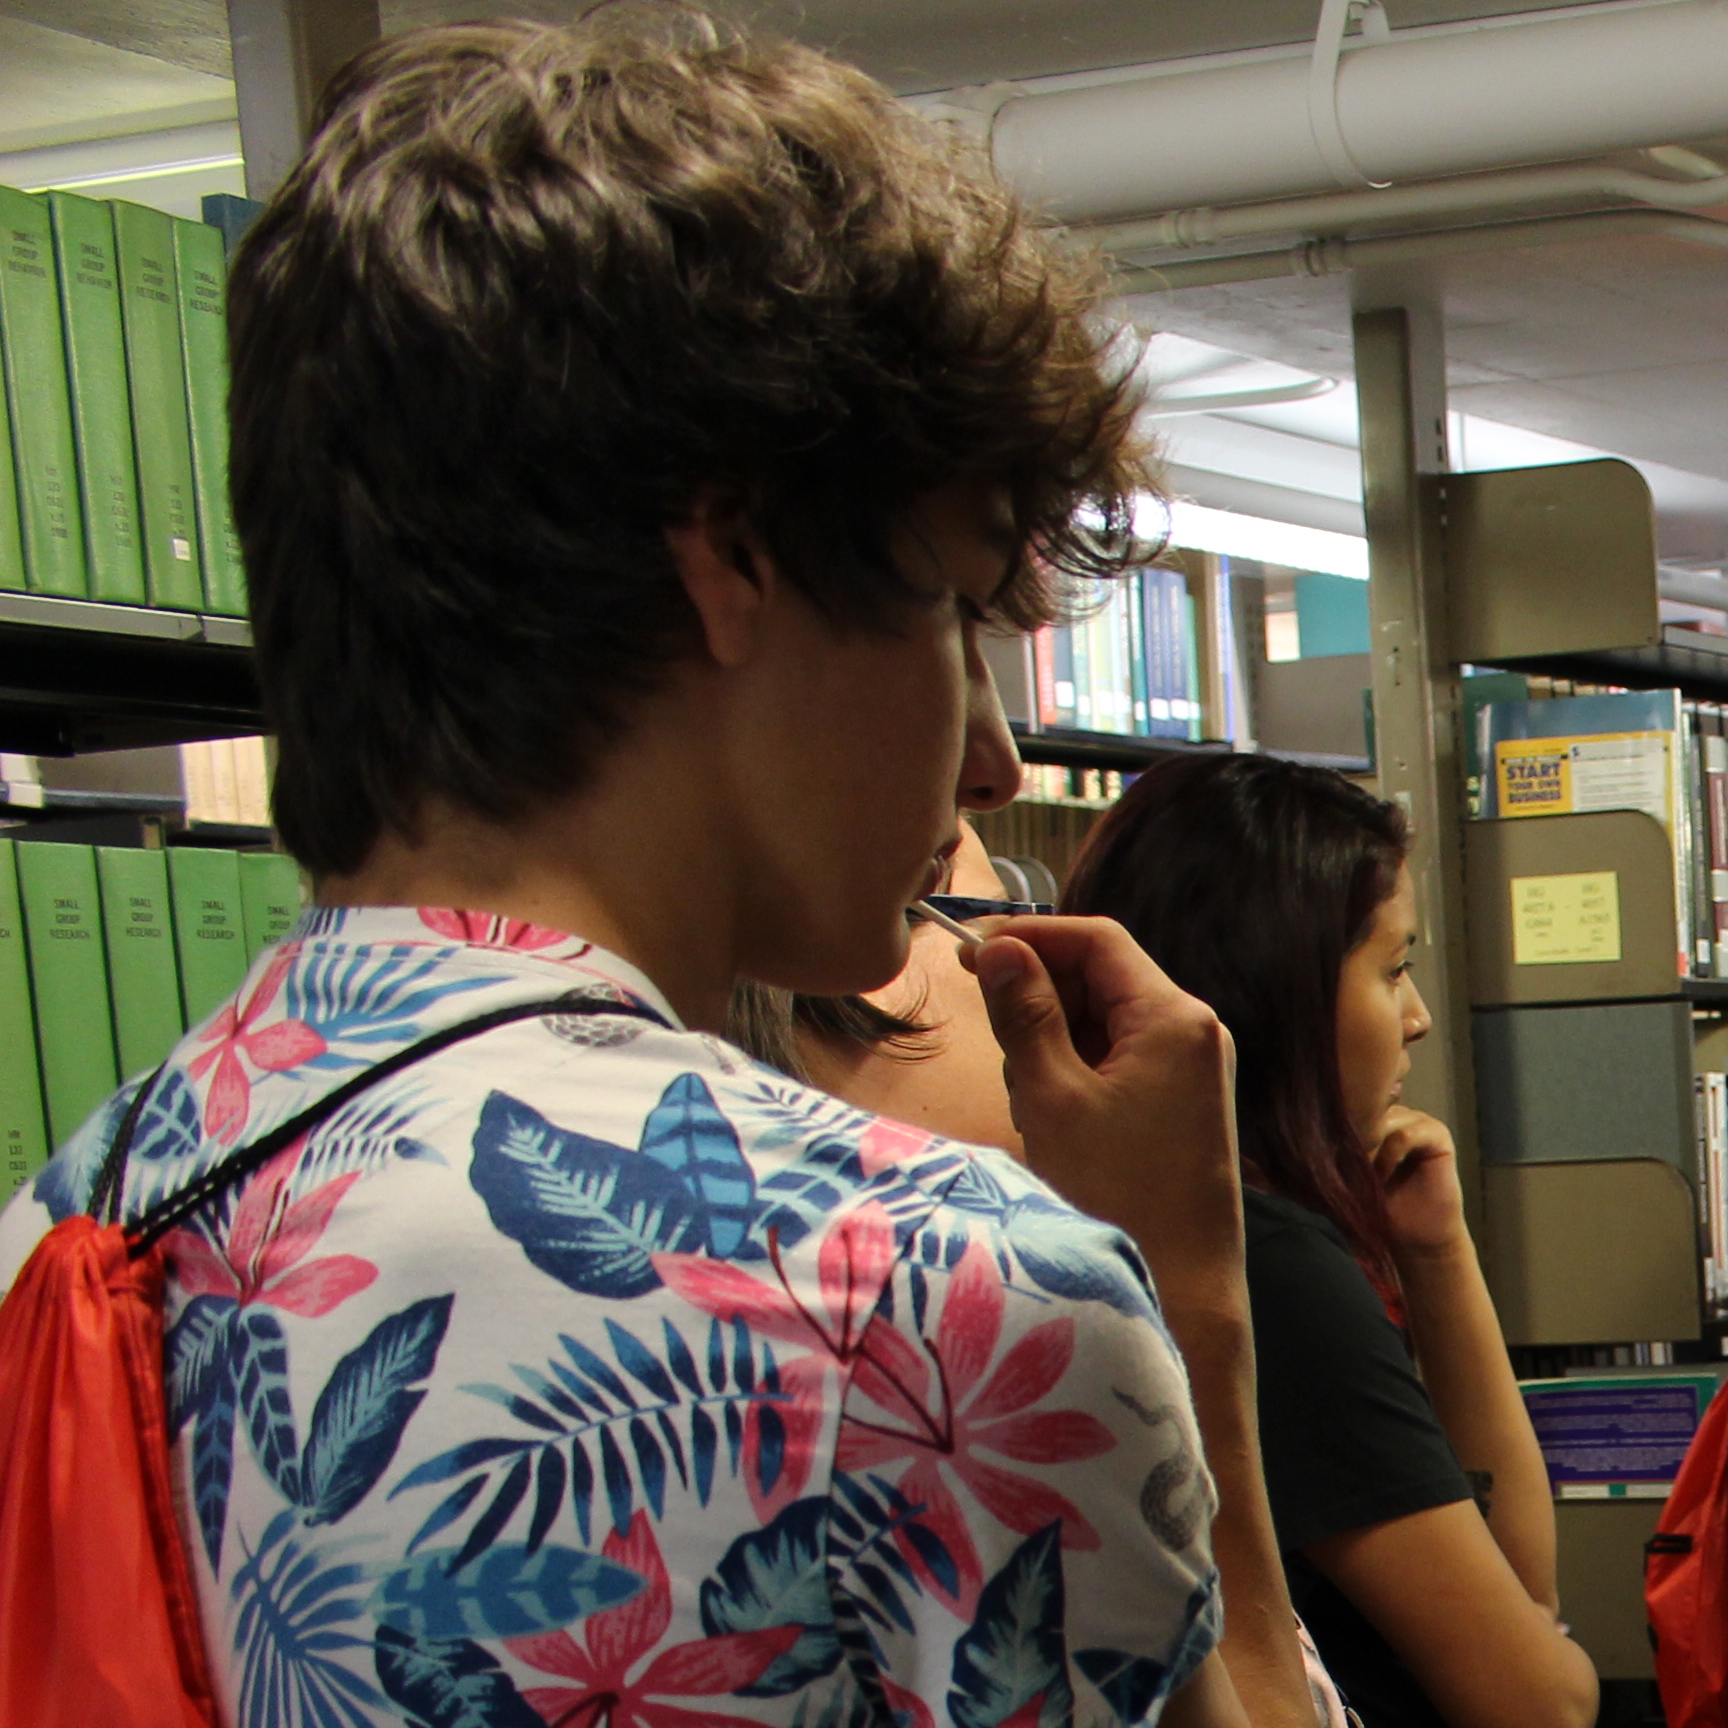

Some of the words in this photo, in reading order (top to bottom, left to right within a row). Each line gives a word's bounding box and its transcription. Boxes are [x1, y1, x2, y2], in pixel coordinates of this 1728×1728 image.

[1507, 762, 1561, 780] START
[54, 898, 79, 910] SMALL
[130, 897, 152, 909] SMALL
[201, 900, 226, 911] SMALL
[267, 905, 290, 917] SMALL
[55, 913, 81, 925] GROUP
[131, 912, 154, 923] GROUP
[202, 914, 227, 925] GROUP
[268, 920, 291, 931] GROUP
[50, 928, 90, 940] RESEARCH
[125, 926, 162, 938] RESEARCH
[196, 928, 235, 940] RESEARCH
